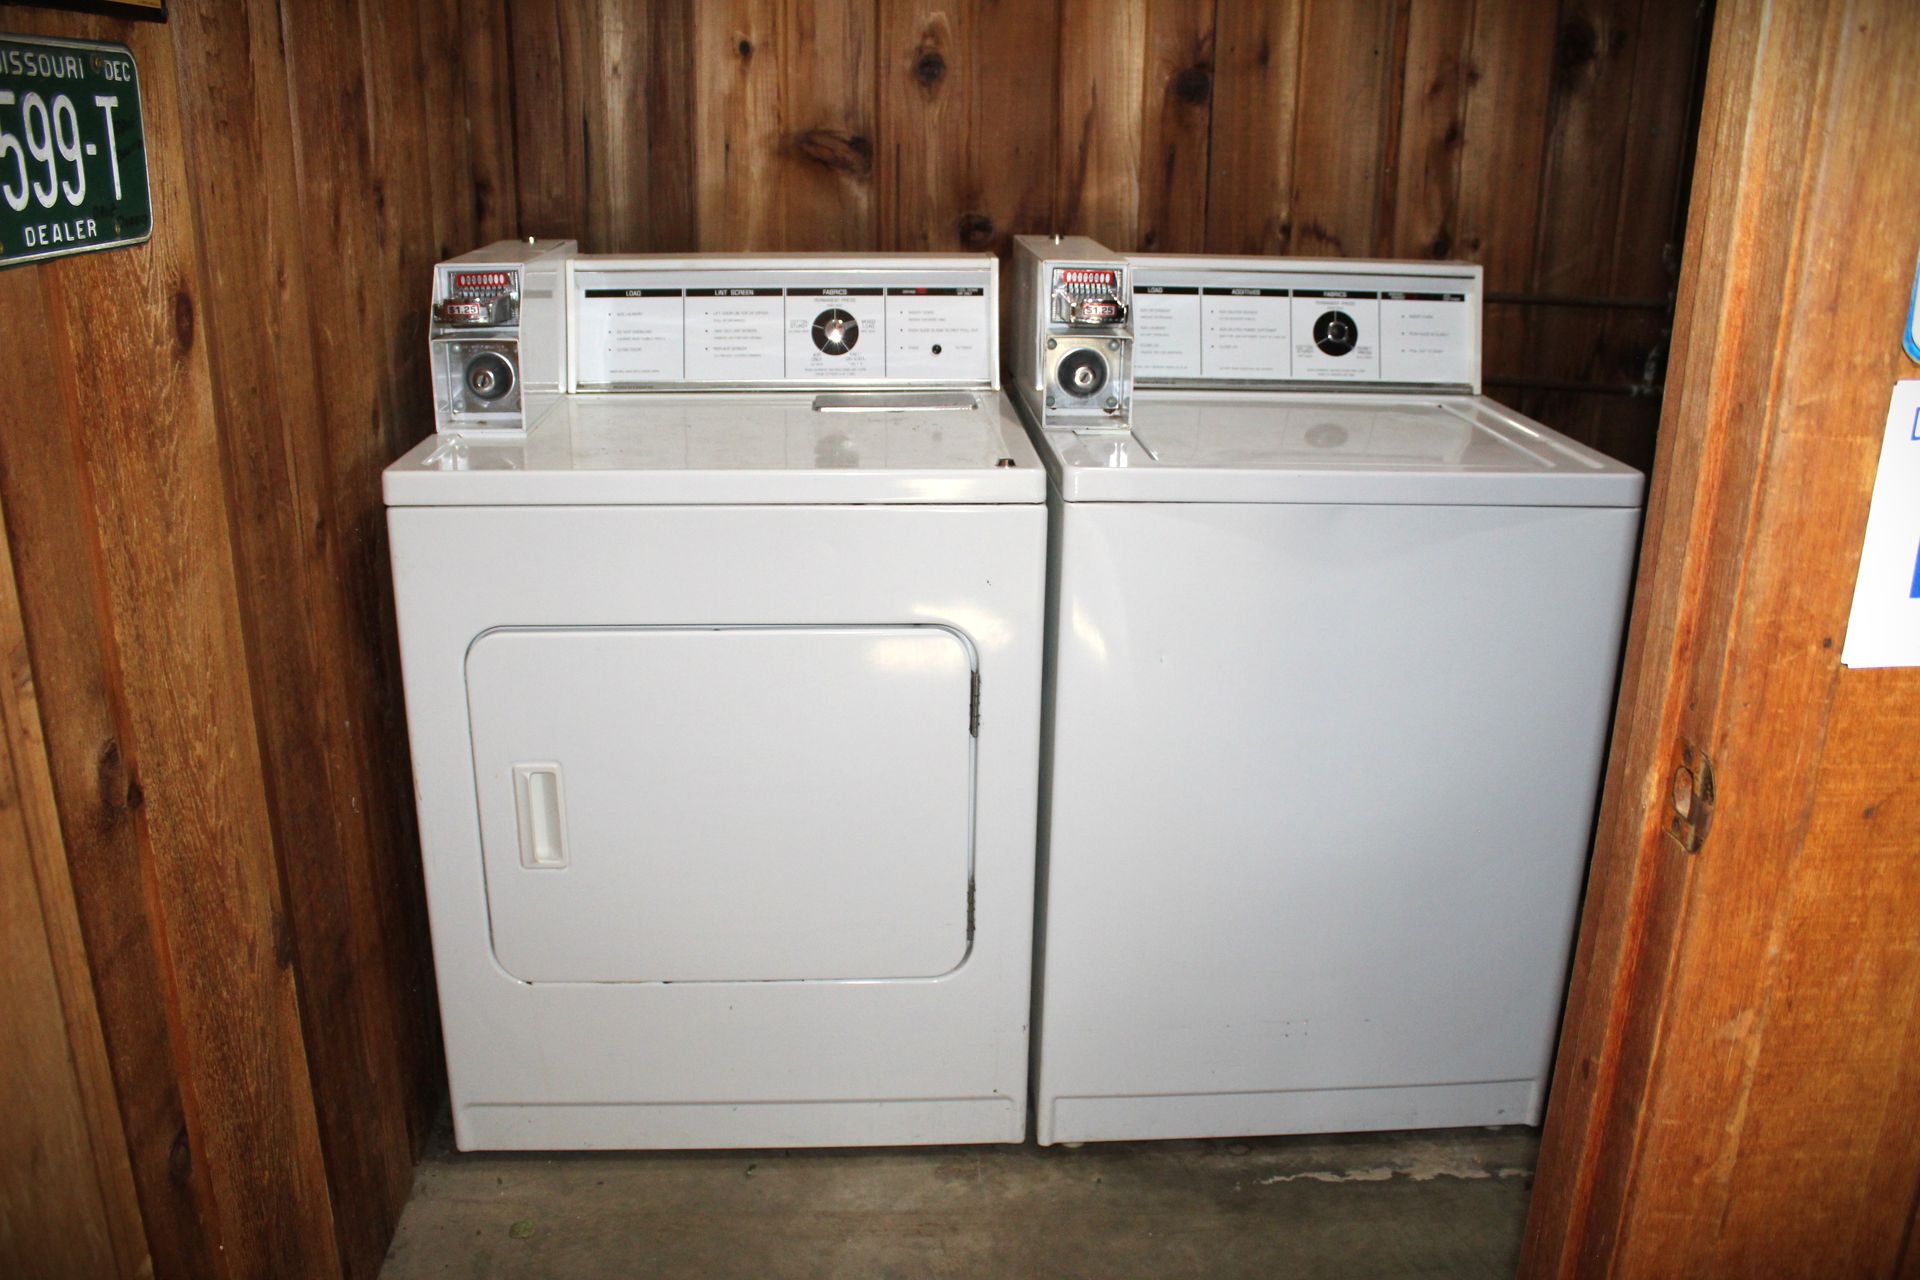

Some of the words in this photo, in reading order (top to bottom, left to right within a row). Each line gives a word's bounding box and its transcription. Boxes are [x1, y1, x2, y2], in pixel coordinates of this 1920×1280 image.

[0, 50, 84, 79] ISSOURI
[105, 60, 132, 82] DEC
[0, 90, 121, 212] 599-T
[25, 218, 97, 248] DEALER
[625, 289, 641, 297] LOAD
[714, 289, 728, 297] LINT
[730, 289, 754, 297] SCREEN
[822, 288, 848, 296] FABRICS
[1323, 290, 1347, 298] FABRICS
[448, 304, 478, 315] $1.25
[1086, 304, 1114, 315] $1.25
